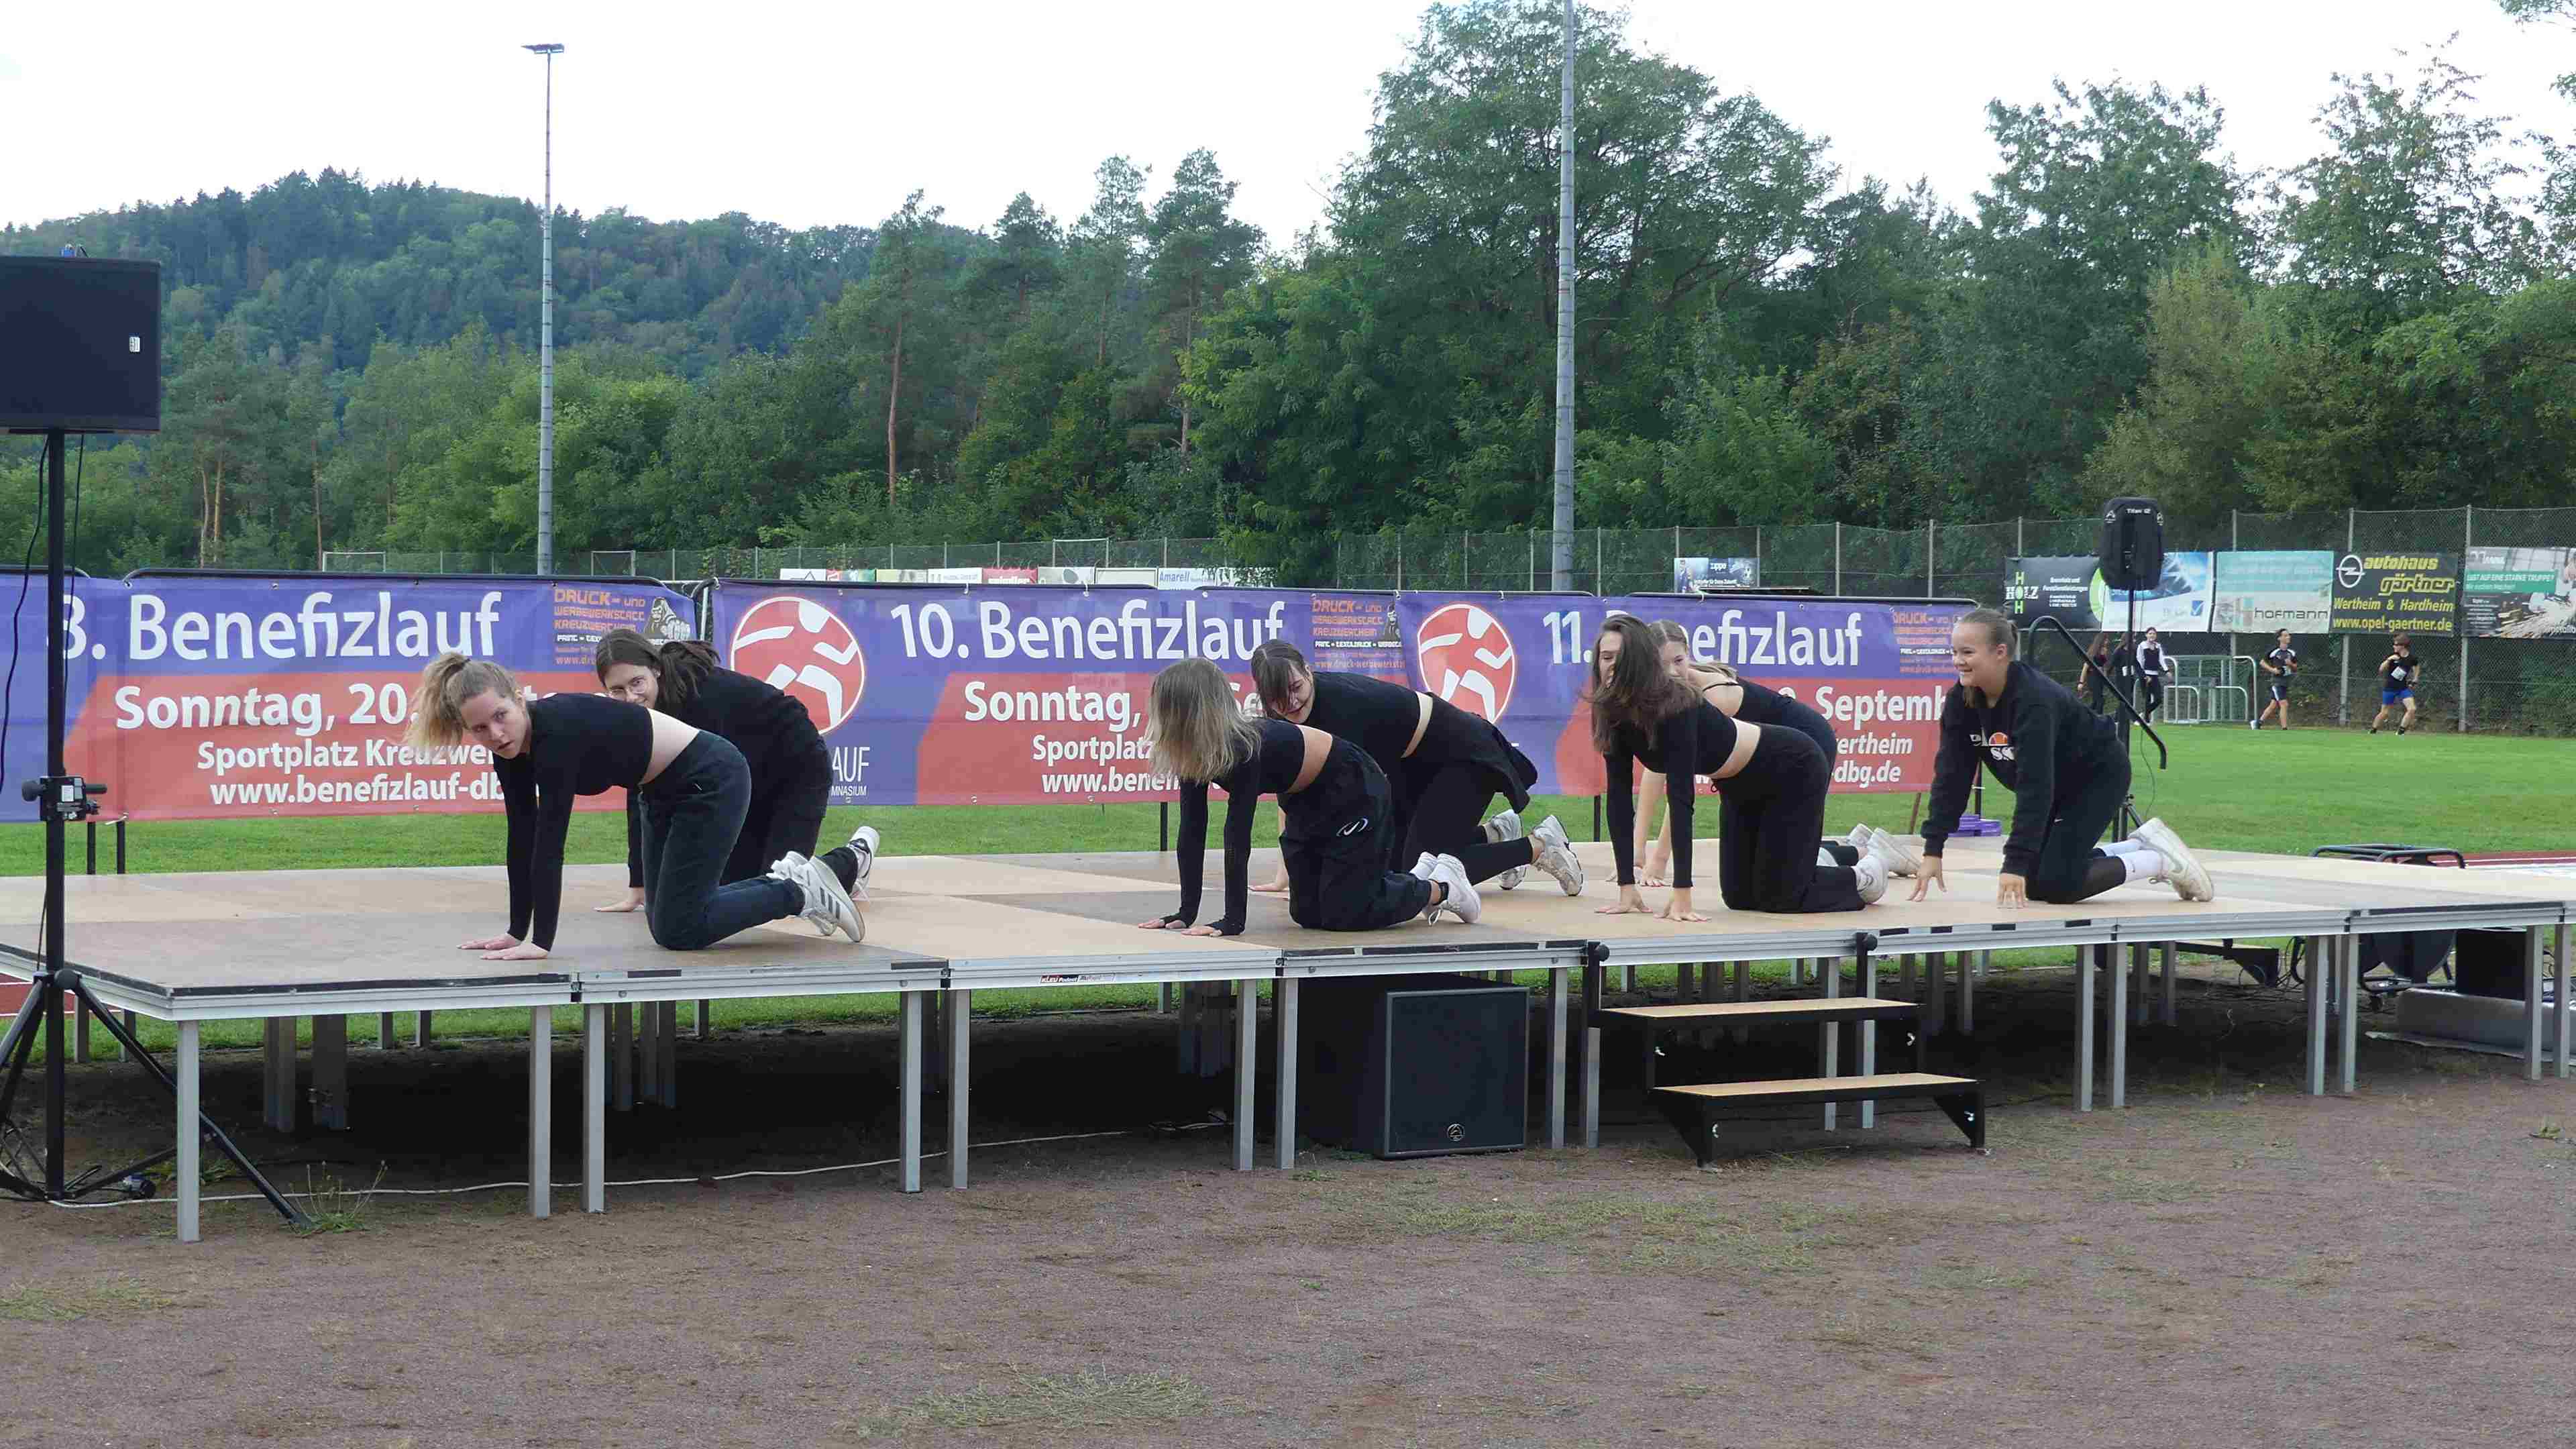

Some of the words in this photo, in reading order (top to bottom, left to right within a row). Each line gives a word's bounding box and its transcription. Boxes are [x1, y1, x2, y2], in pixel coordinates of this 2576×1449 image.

[1159, 571, 1190, 582] Amarell
[2363, 555, 2438, 570] autohaus
[2378, 572, 2455, 596] gärtner
[2334, 597, 2381, 610] Wertheim
[2386, 598, 2394, 611] &
[2400, 598, 2454, 612] Hardheim
[129, 591, 502, 660] Benefizlauf
[891, 602, 969, 659] 10.
[980, 599, 1284, 660] Benefizlauf
[1543, 611, 1593, 664] 11.
[2333, 615, 2453, 633] www.opel-gaertner.de
[115, 685, 335, 737] Sonntag,
[964, 681, 1141, 732] Sonntag,
[197, 739, 358, 775] Sportplatz
[832, 747, 870, 782] AUF
[831, 785, 867, 796] MNASIUM
